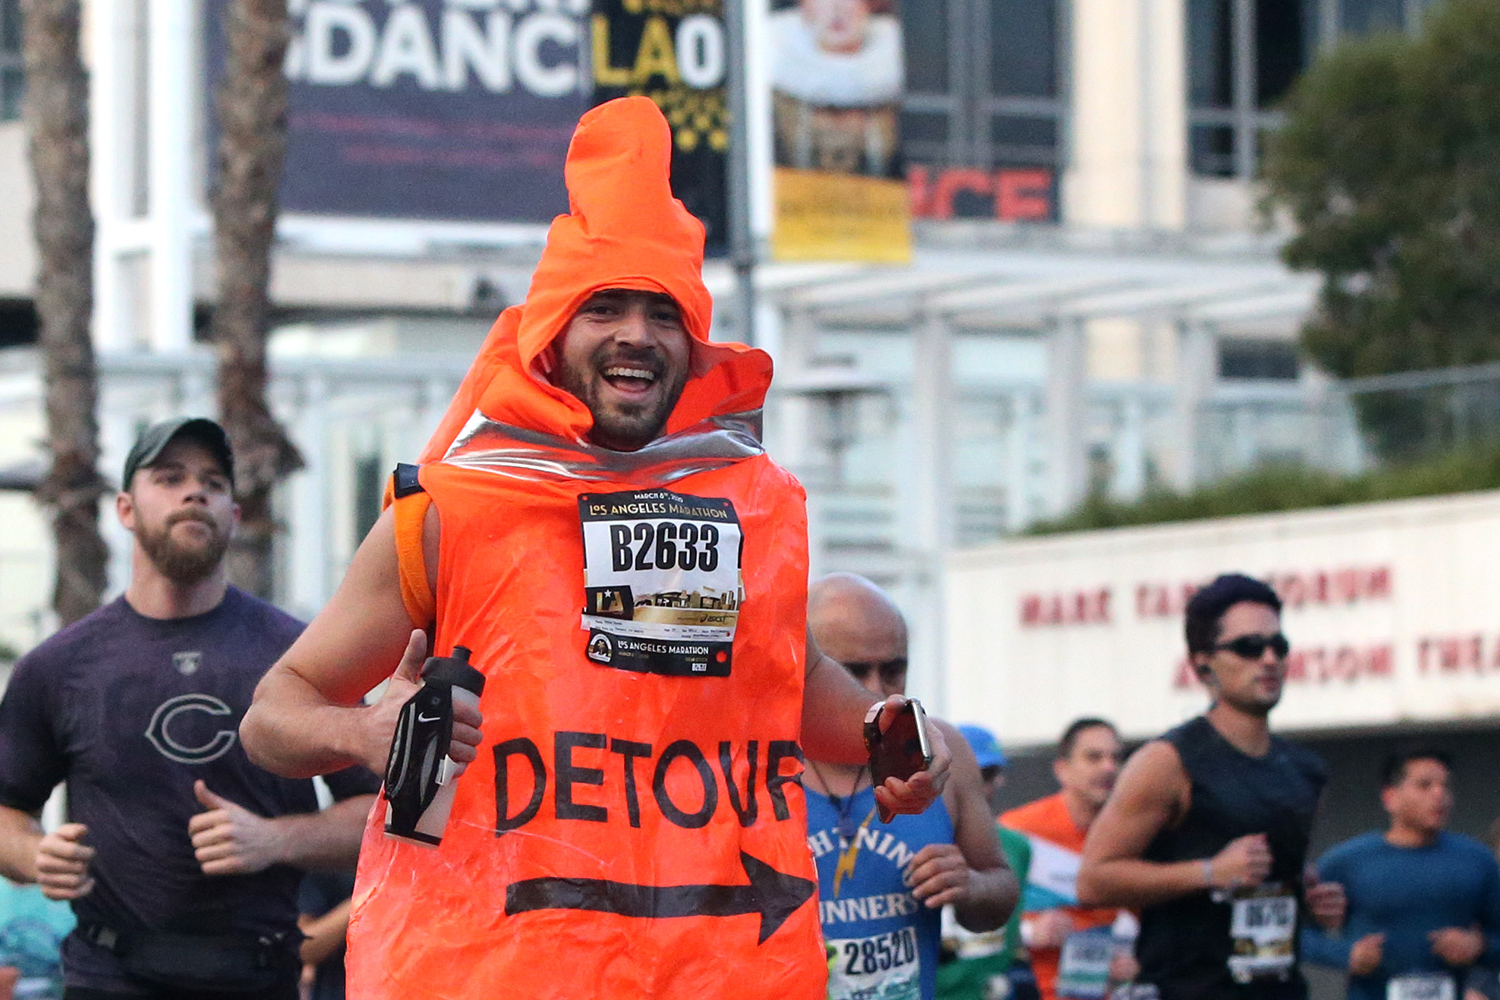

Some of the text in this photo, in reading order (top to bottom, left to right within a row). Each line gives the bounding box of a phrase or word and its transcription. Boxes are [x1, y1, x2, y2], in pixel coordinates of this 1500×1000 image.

[610, 502, 667, 516] ANGELES
[668, 504, 728, 519] MARATHON
[609, 520, 720, 573] B2633
[629, 641, 667, 654] ANGELES
[668, 645, 709, 655] MARATHON
[144, 693, 238, 764] C
[492, 731, 805, 838] DETOUR
[845, 927, 916, 976] 28520
